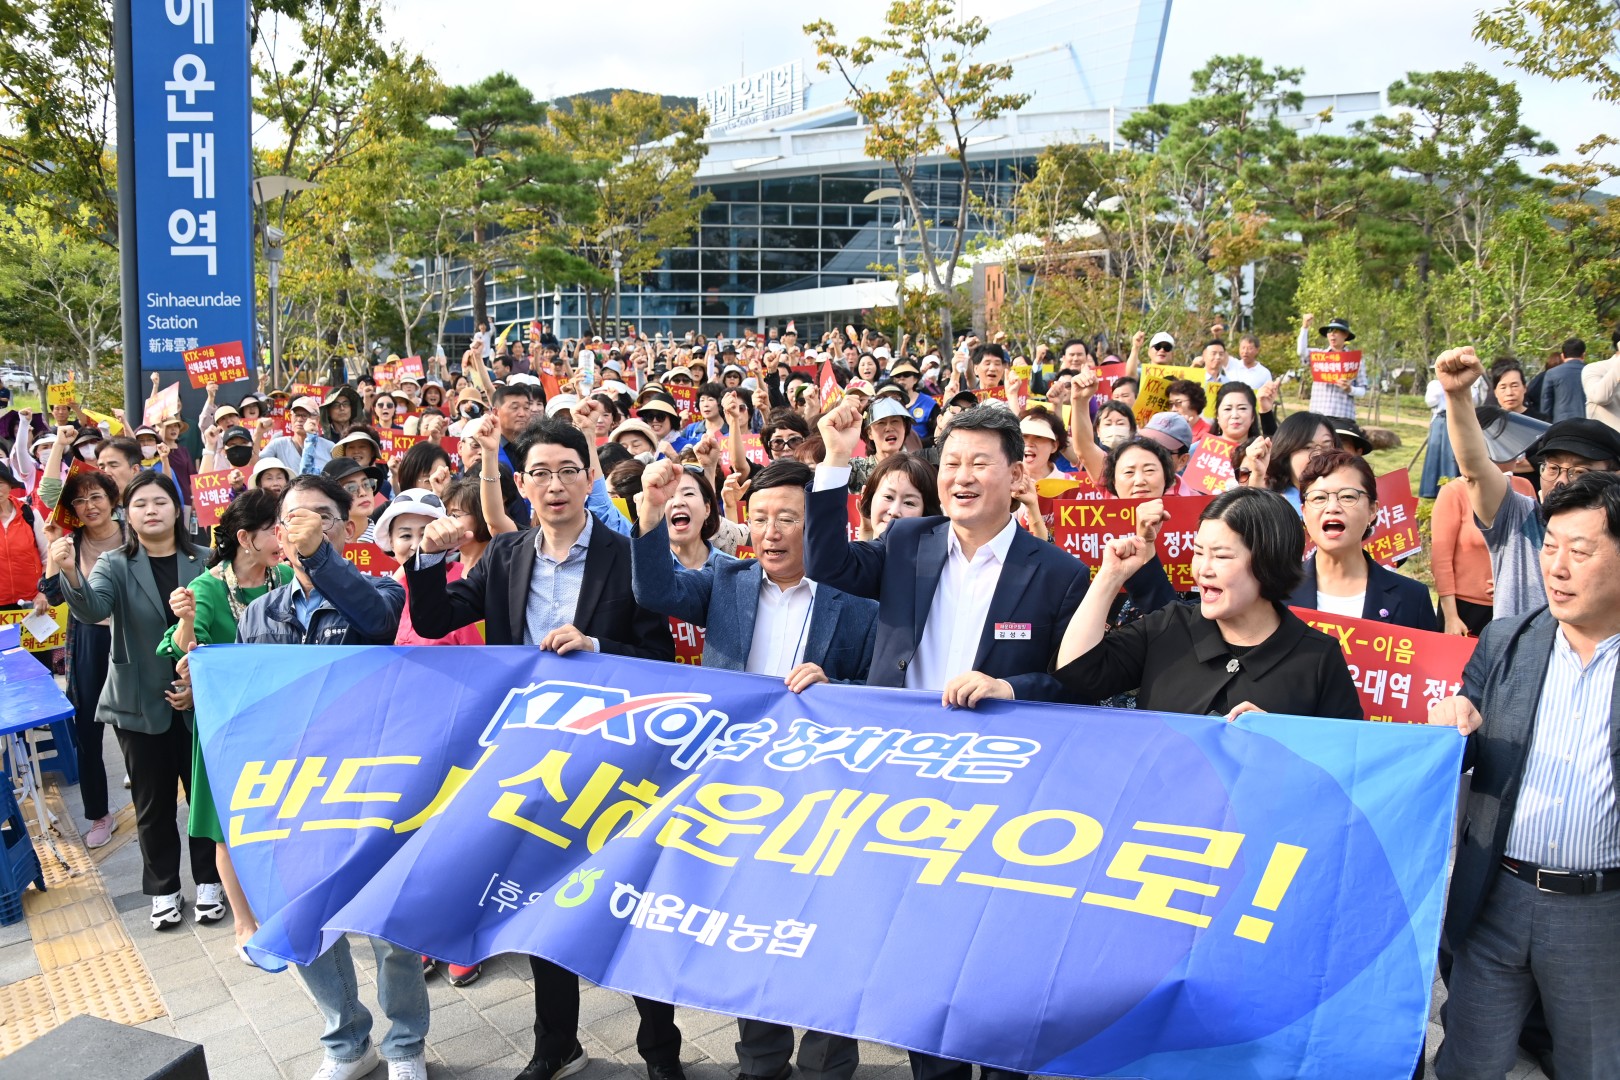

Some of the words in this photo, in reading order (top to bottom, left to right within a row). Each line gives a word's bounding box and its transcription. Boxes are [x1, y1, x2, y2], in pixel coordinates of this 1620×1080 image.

[146, 291, 242, 308] Sinhaeundae
[147, 314, 198, 330] Station
[183, 348, 216, 362] KTX-이음
[188, 359, 218, 375] 신해운대역
[220, 356, 243, 368] 정차로
[220, 367, 247, 380] 발전을!
[199, 487, 233, 506] 신해운
[1060, 505, 1136, 527] KTX-이
